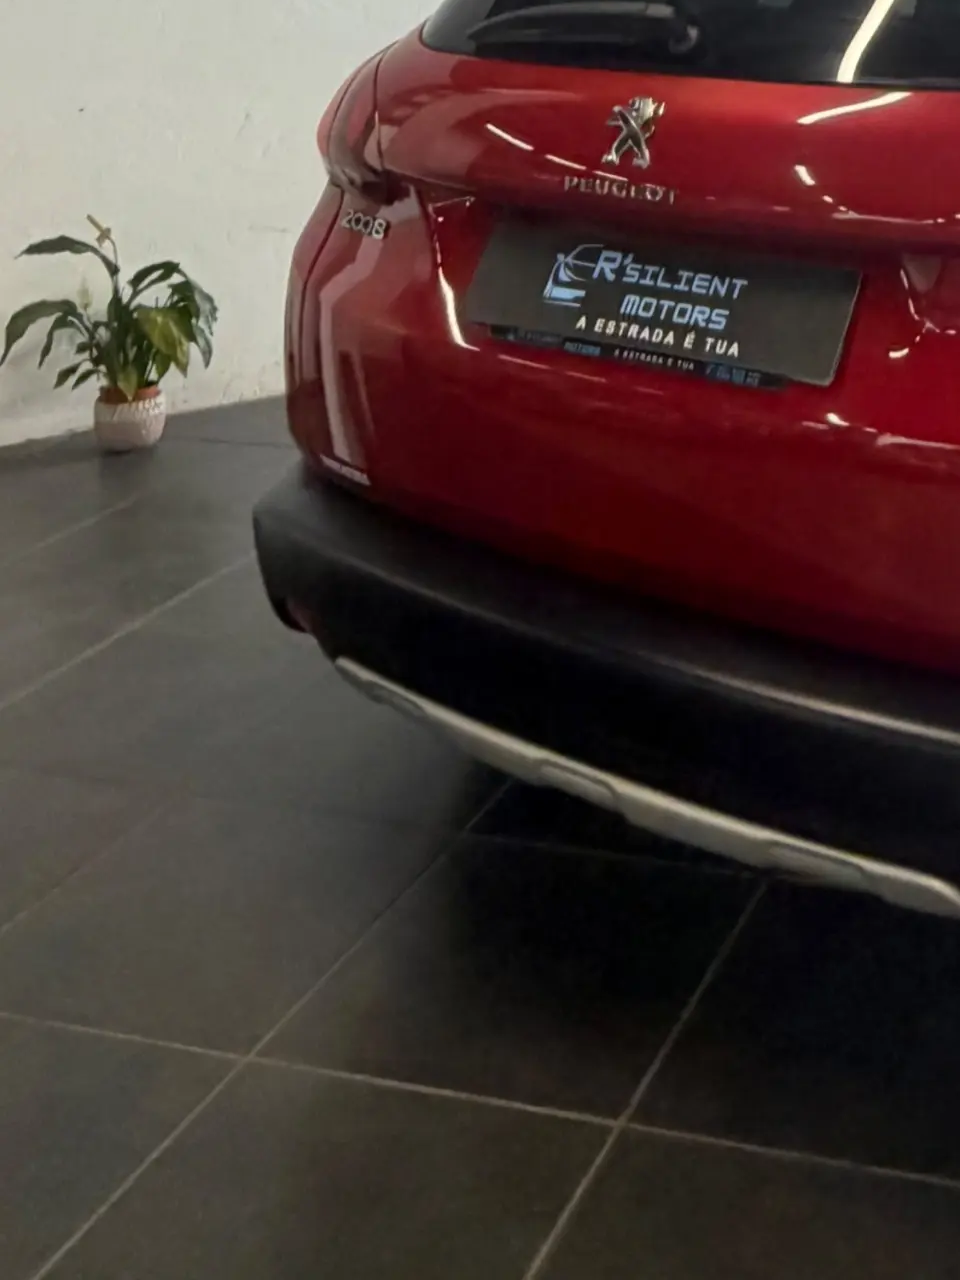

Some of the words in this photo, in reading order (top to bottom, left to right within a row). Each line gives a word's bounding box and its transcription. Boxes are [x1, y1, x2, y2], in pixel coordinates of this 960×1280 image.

[340, 208, 387, 240] 2008
[592, 249, 749, 300] R'SILIENT
[619, 293, 730, 331] MOTORS
[575, 315, 587, 331] A
[593, 317, 675, 348] ESTRADA
[683, 330, 697, 350] É
[704, 336, 740, 358] TUA
